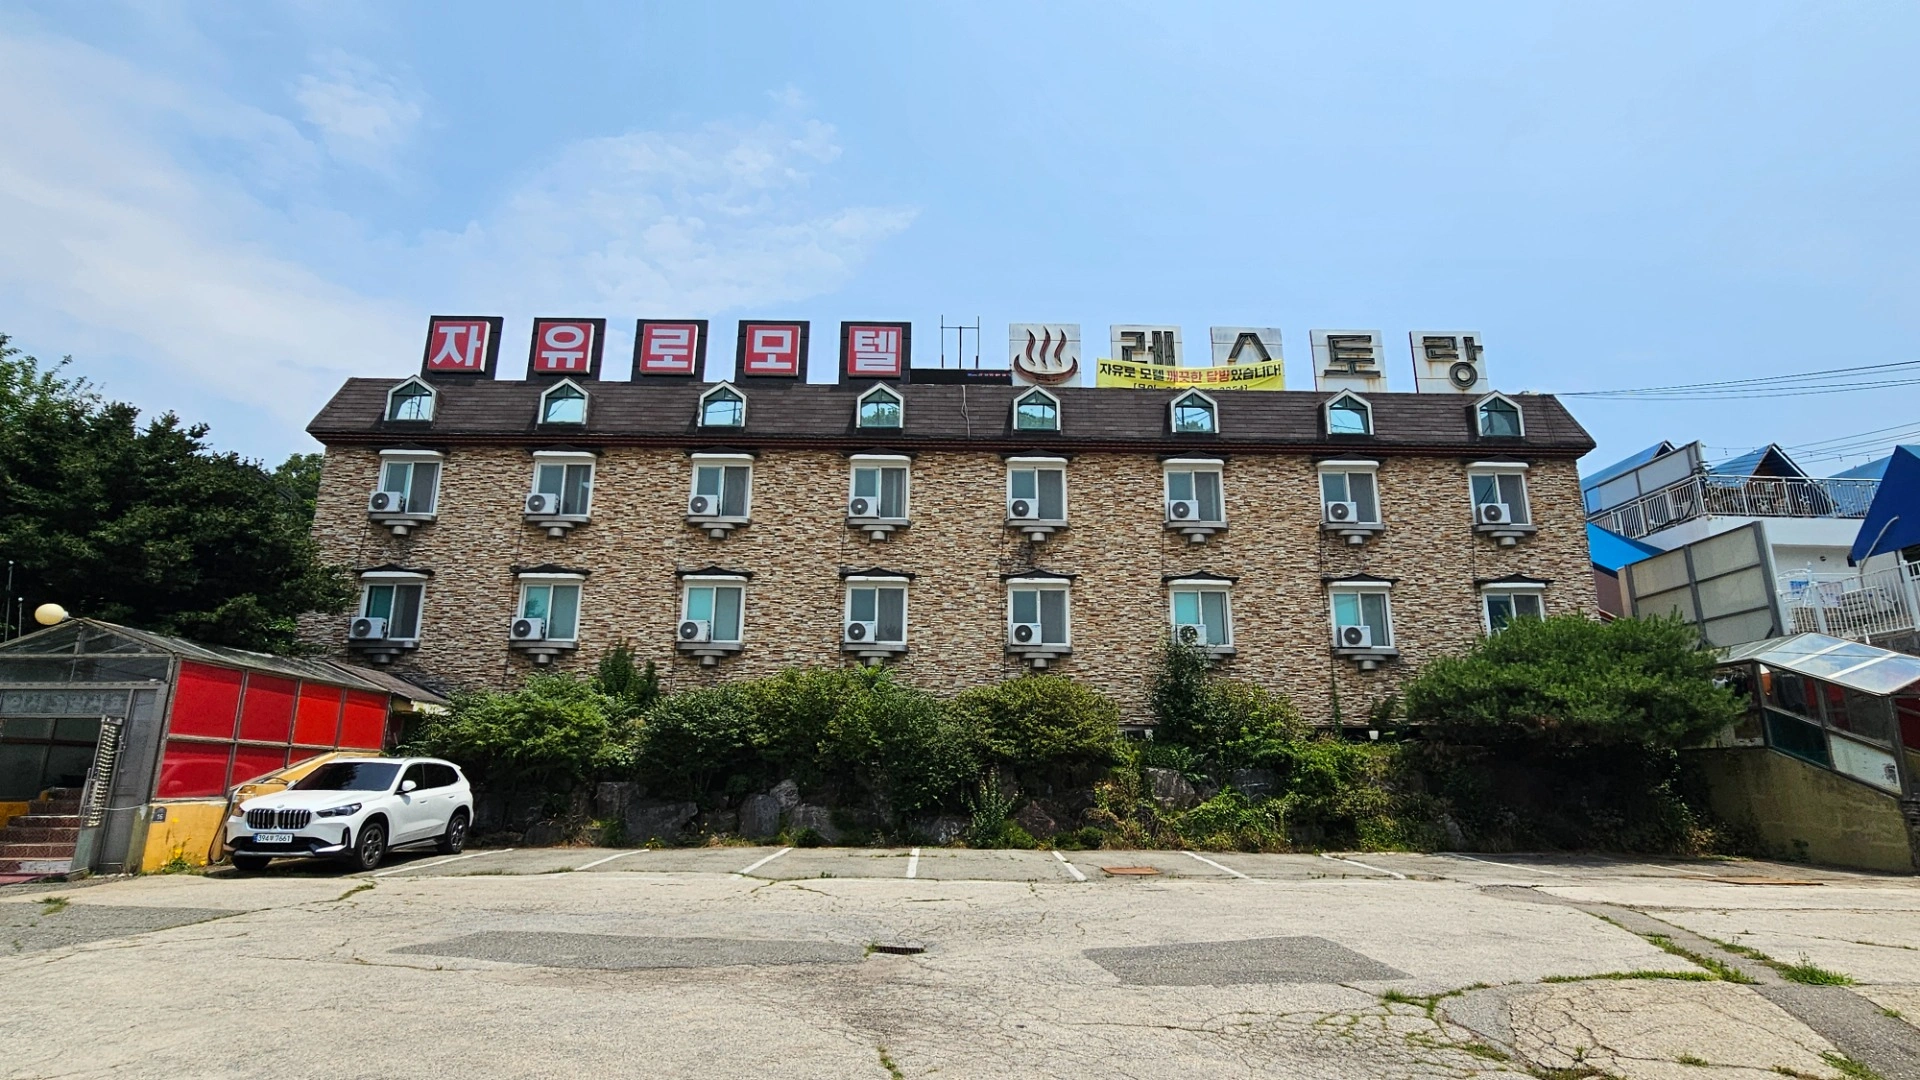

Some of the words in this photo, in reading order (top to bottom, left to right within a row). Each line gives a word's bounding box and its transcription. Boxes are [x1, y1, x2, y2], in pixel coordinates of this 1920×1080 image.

[1099, 363, 1136, 378] 자유로
[1140, 367, 1165, 381] 모텔
[1166, 370, 1203, 383] 깨끗한
